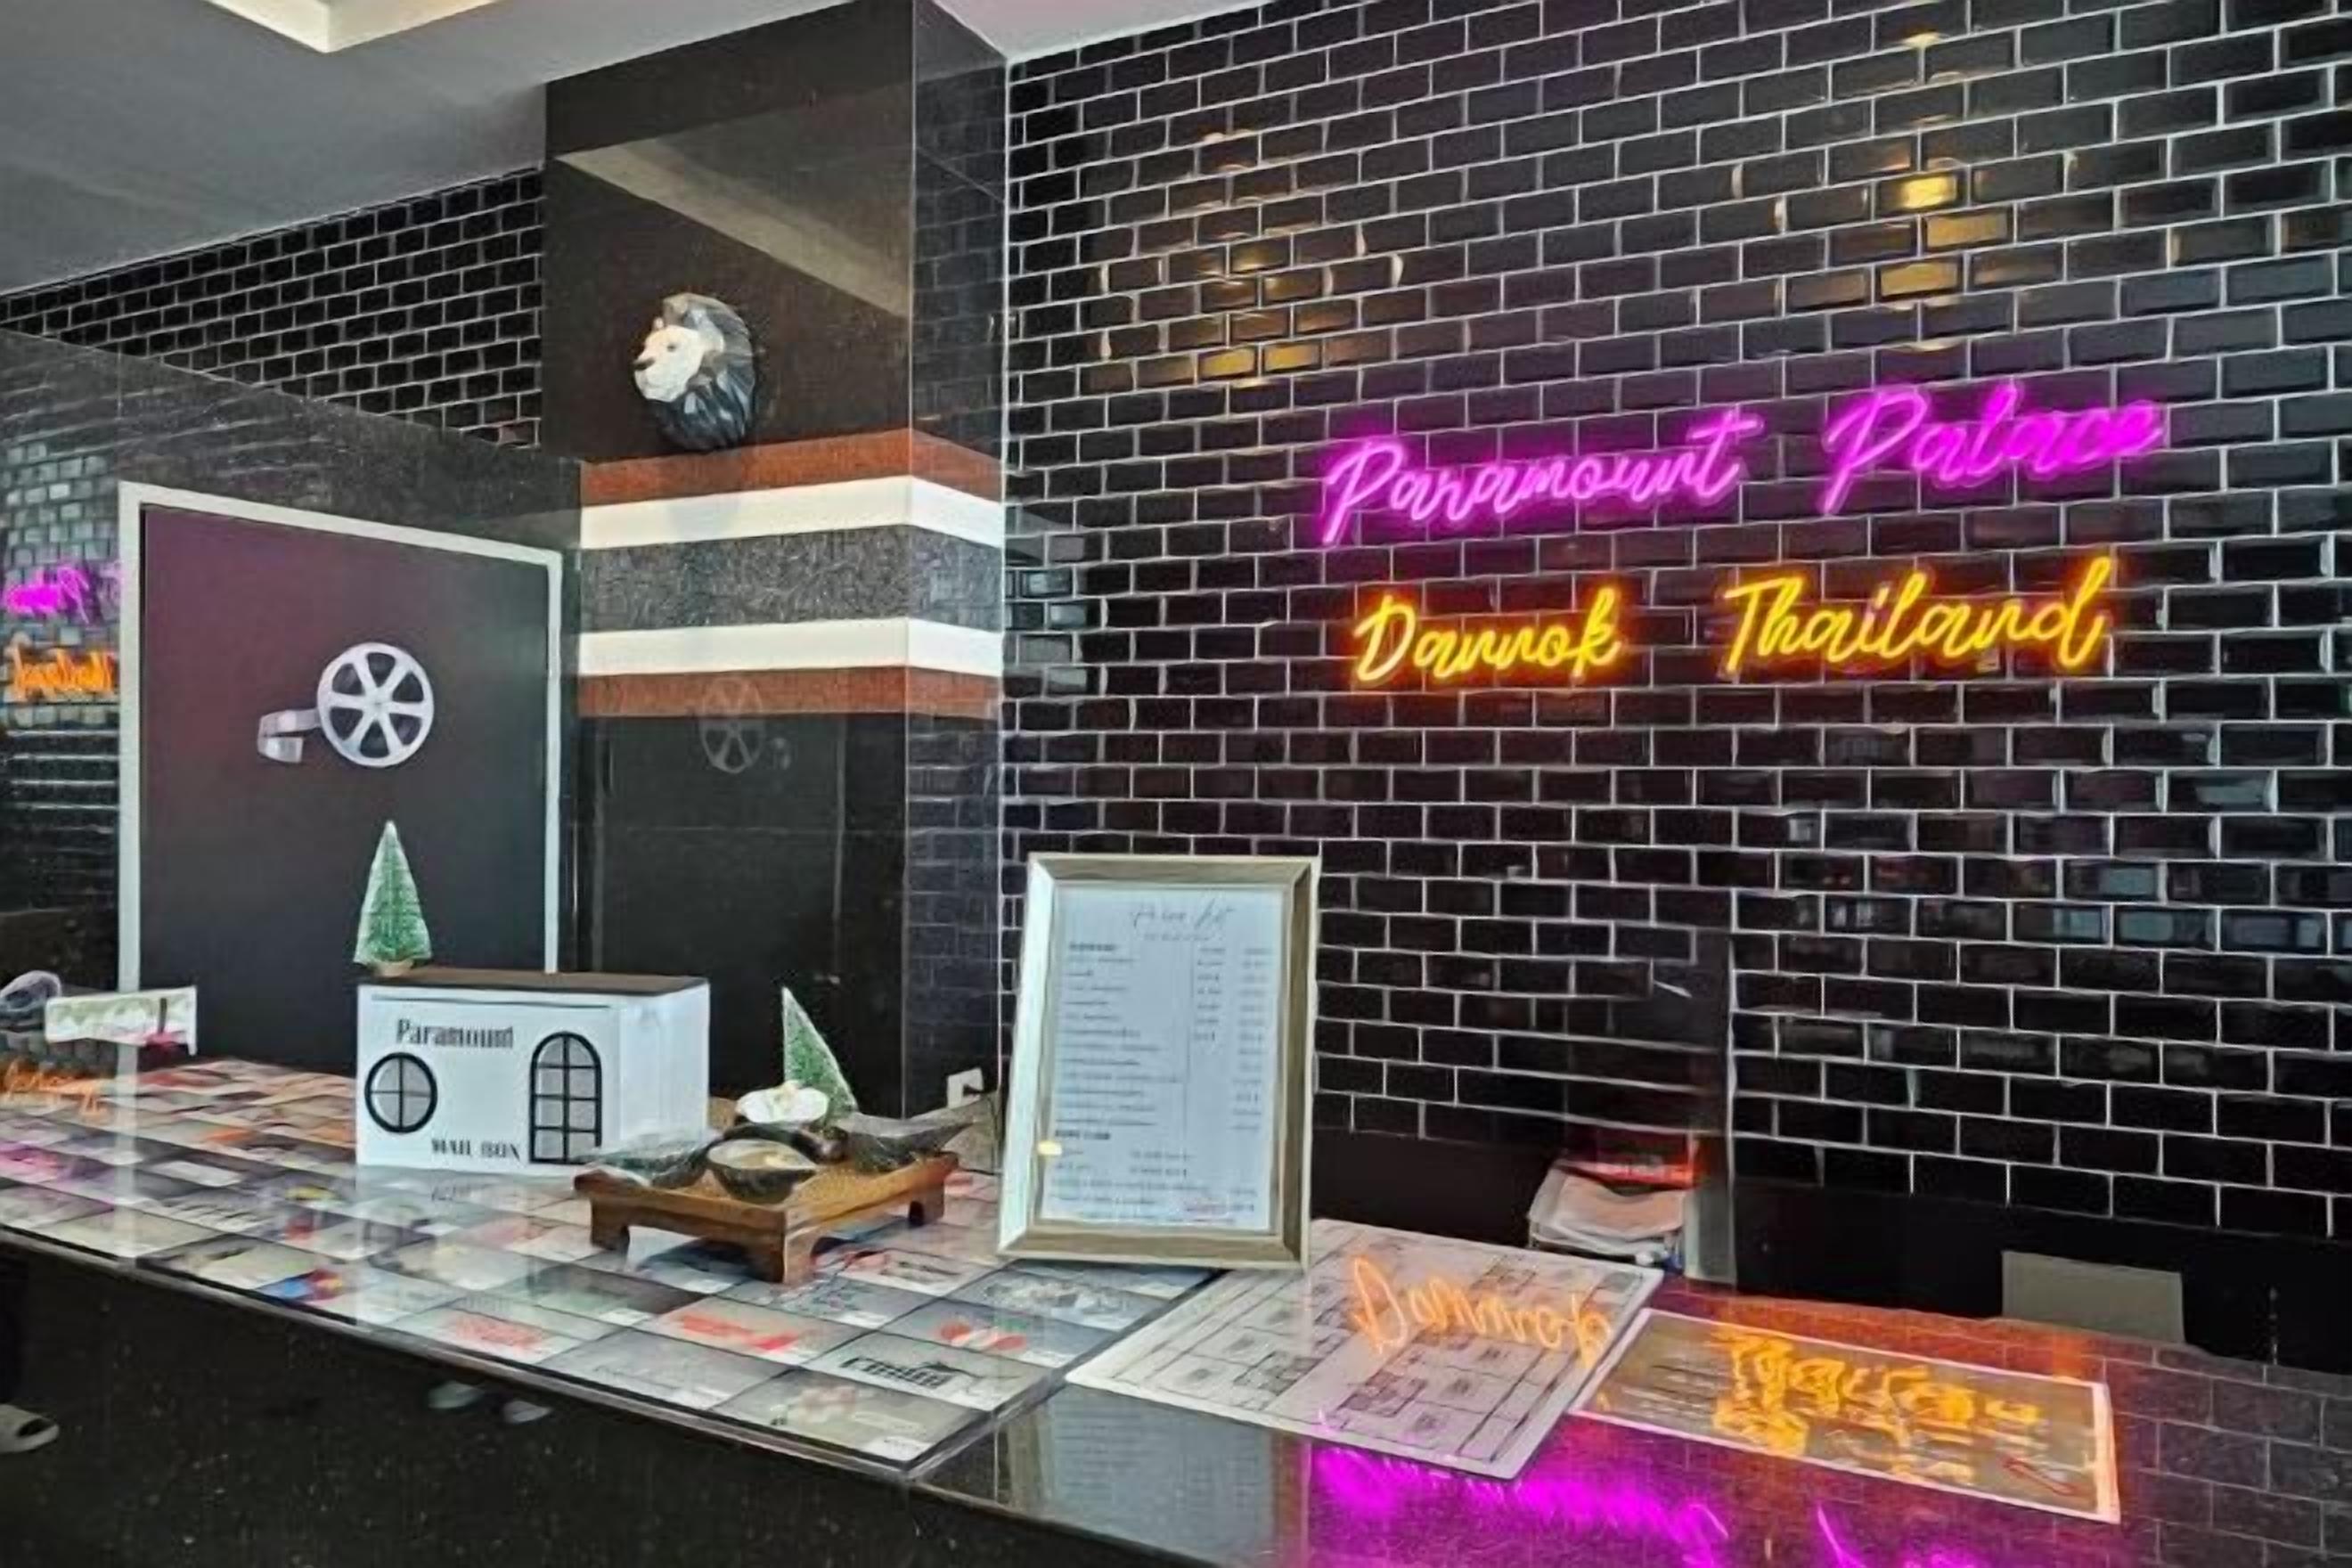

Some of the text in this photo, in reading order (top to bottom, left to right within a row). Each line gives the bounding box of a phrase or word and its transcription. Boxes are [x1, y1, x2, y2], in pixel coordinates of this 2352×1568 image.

[1320, 381, 2164, 545] Paramount Palace
[1724, 556, 2112, 674] Thailand
